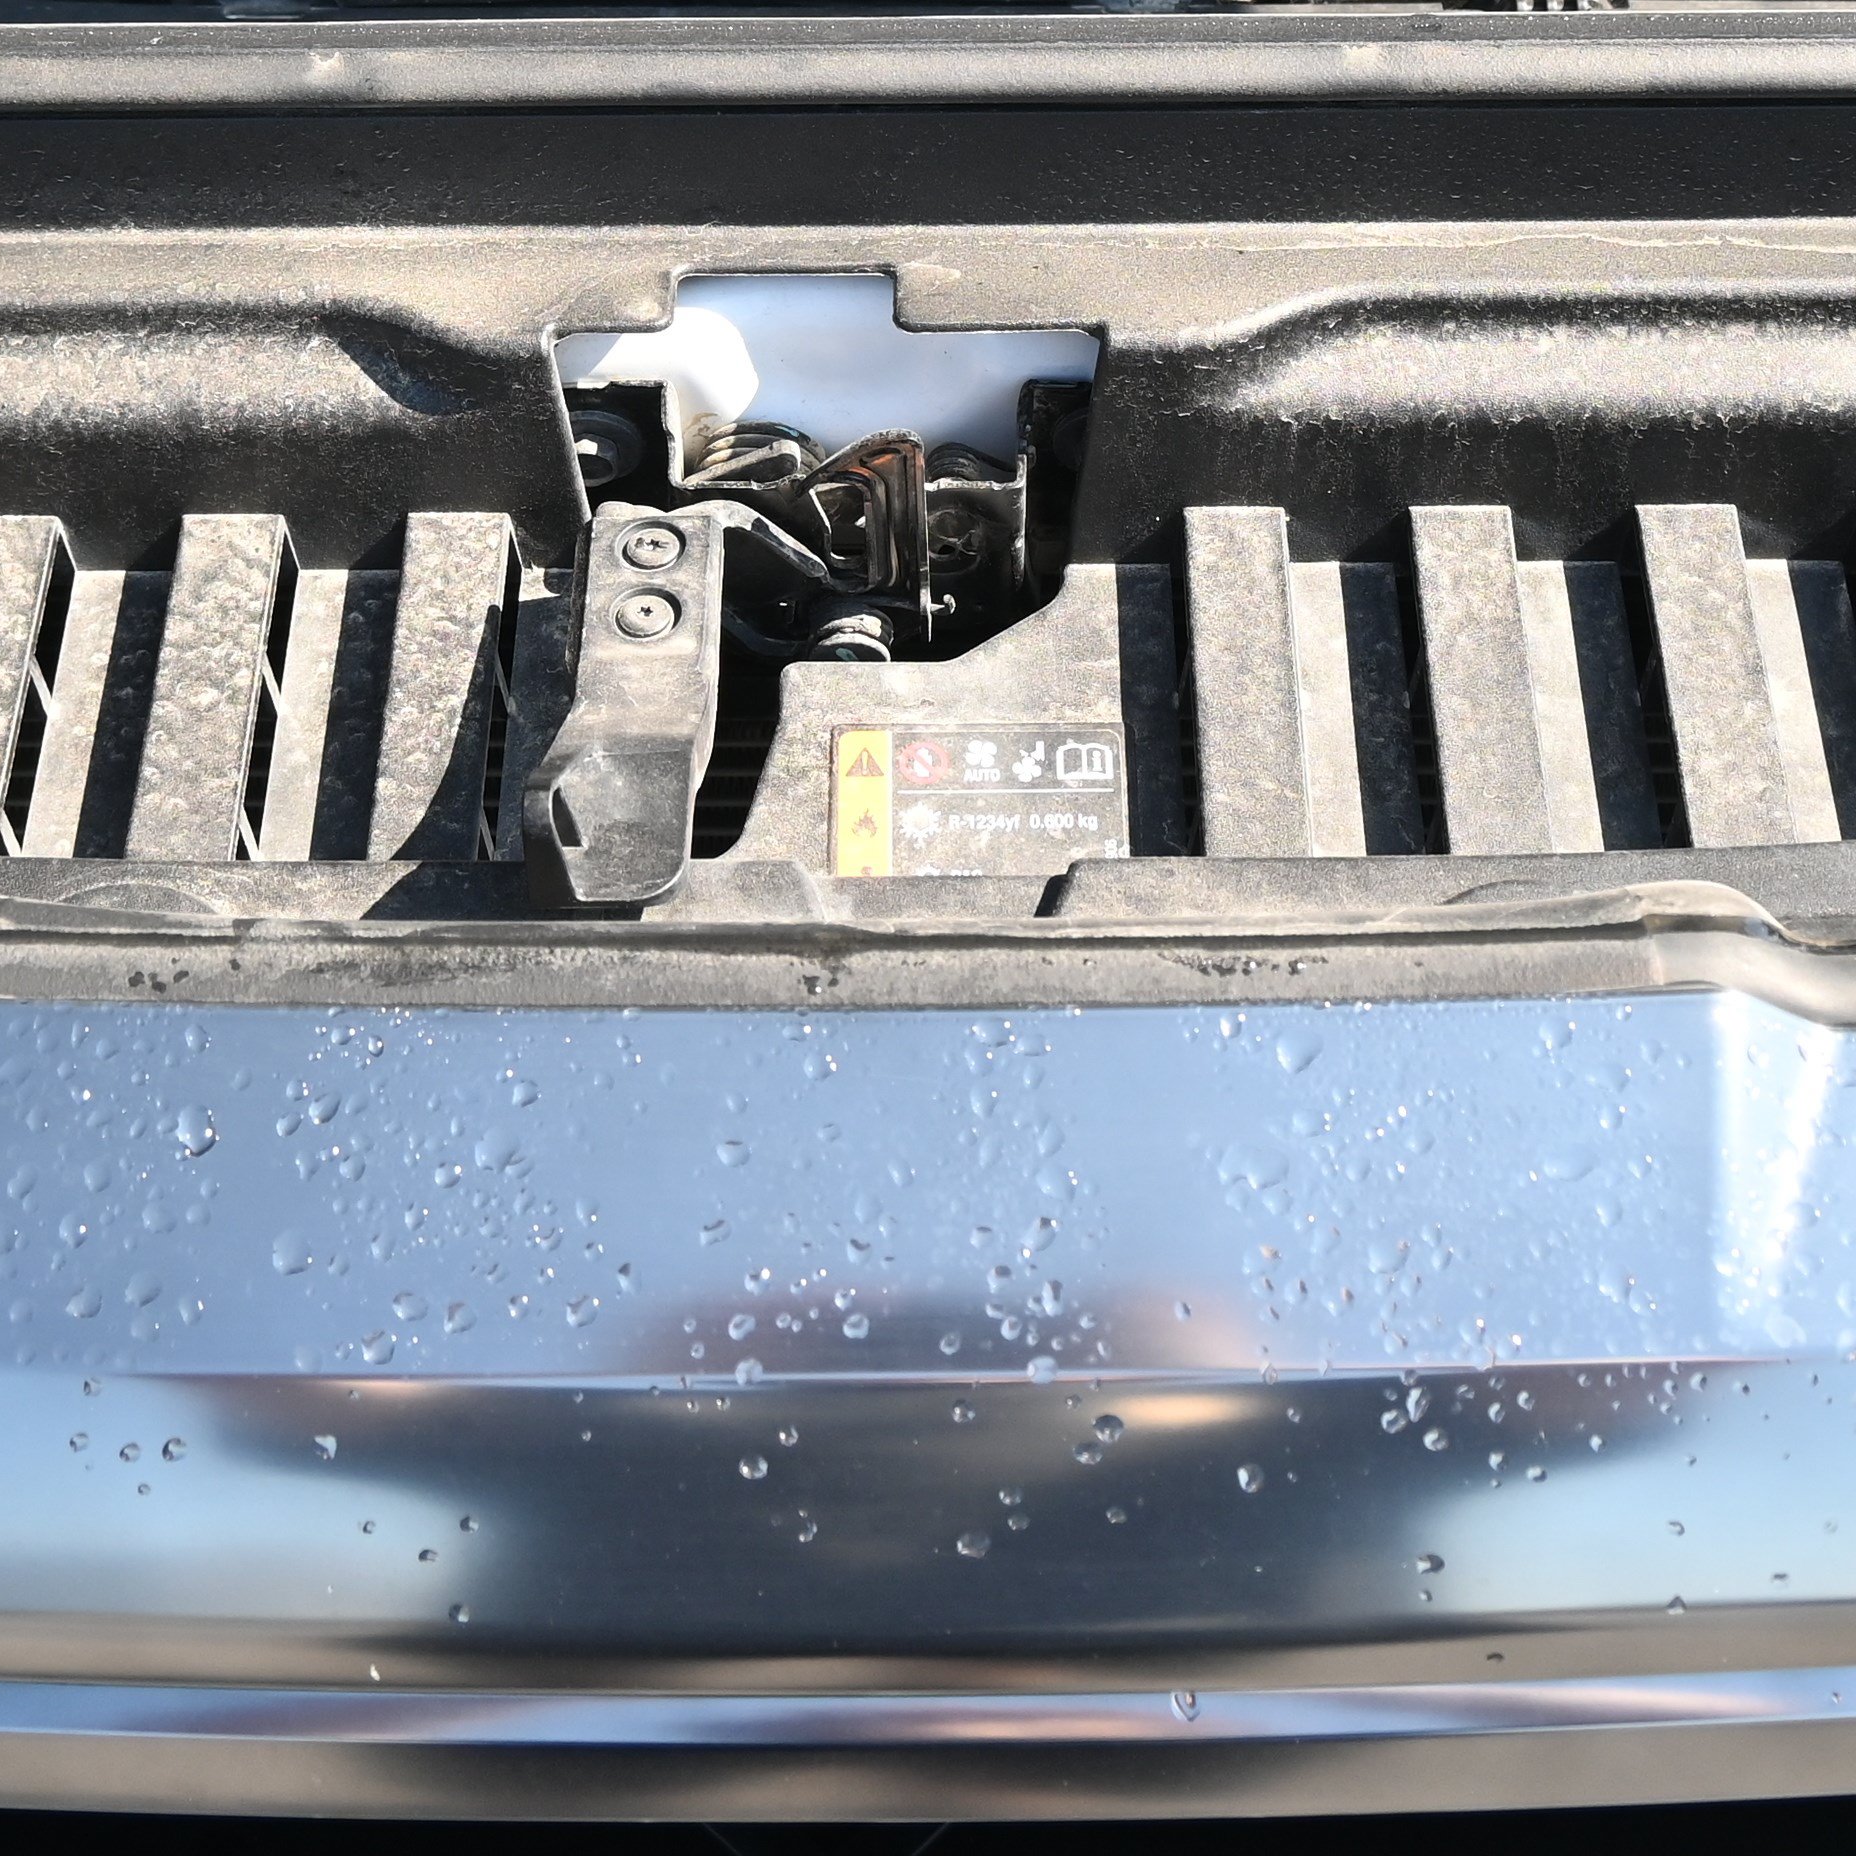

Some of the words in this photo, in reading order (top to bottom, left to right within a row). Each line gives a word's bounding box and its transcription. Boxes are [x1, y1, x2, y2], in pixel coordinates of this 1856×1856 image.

[963, 768, 1001, 783] AUTO
[948, 813, 1020, 832] R-1234yf
[1078, 813, 1098, 831] kg
